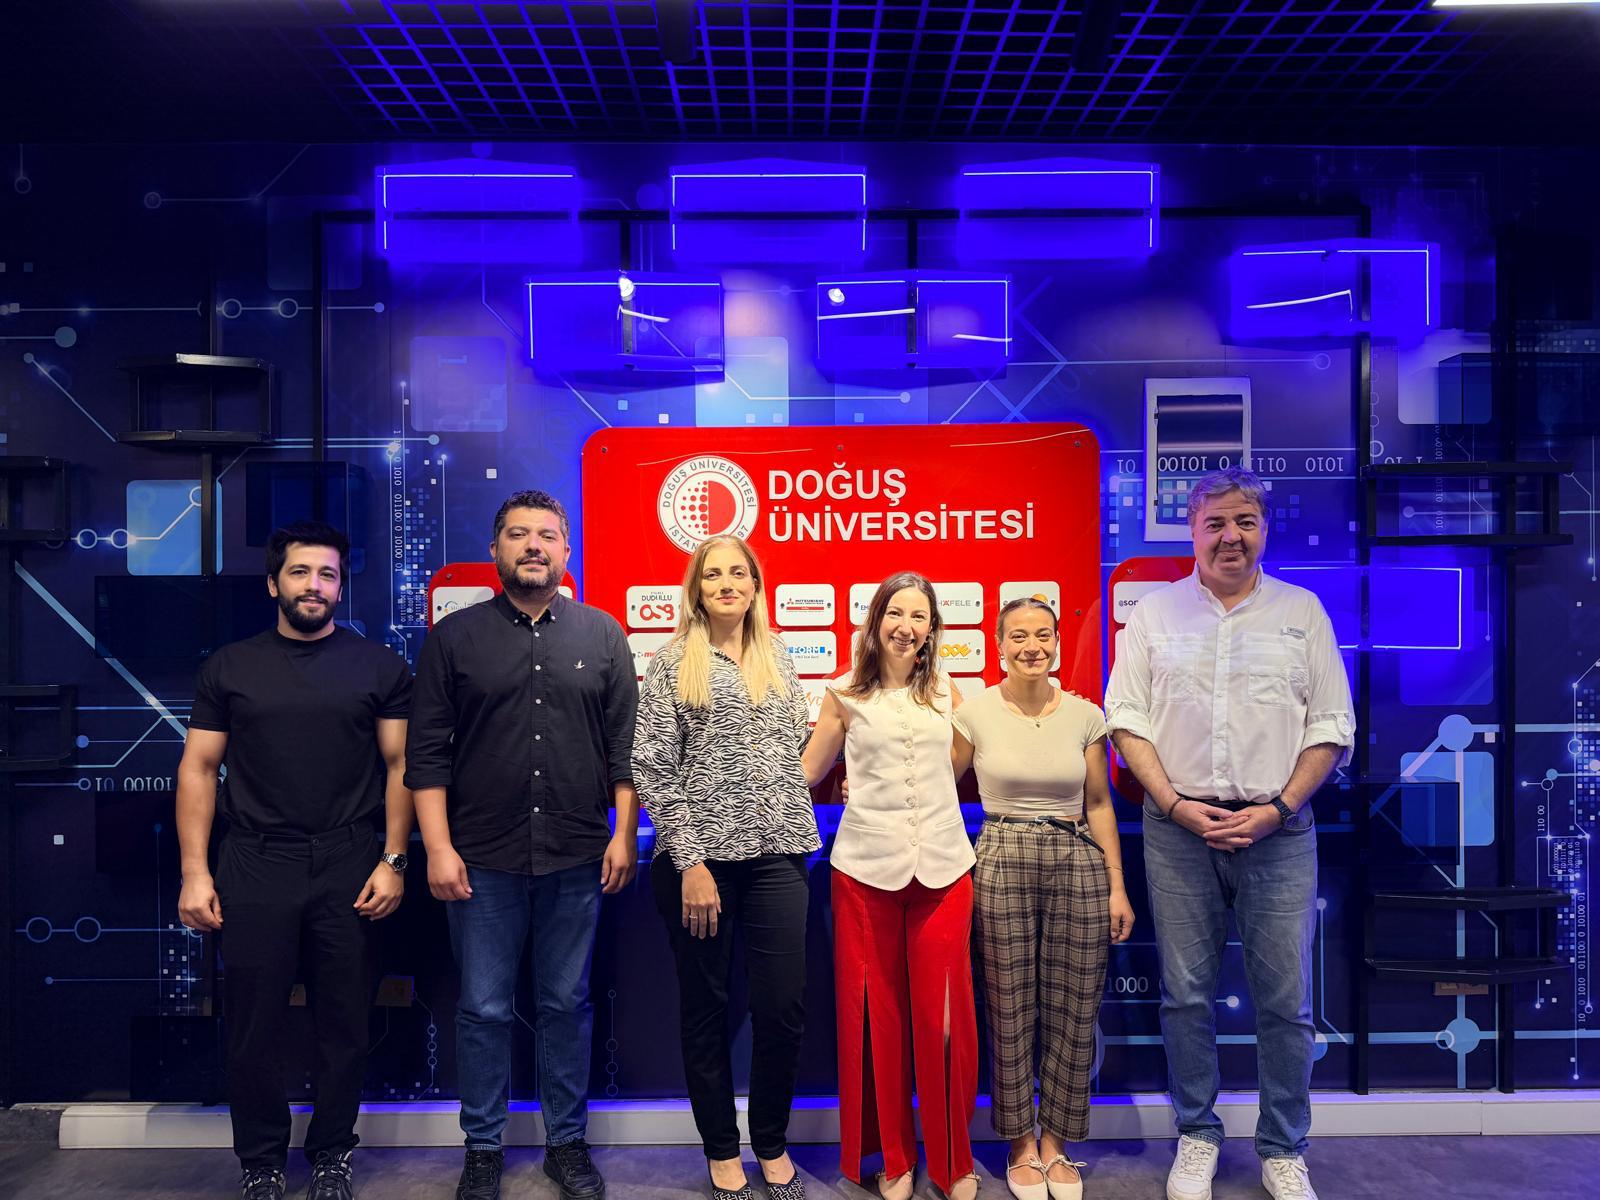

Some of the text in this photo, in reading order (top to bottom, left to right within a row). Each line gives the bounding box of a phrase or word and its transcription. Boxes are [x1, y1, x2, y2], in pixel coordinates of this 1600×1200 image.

[663, 459, 756, 508] DOĞUŞ ÜNİVERSİTESİ
[768, 462, 907, 507] DOĞUŞ
[768, 502, 1035, 542] ÜNİVERSİTESİ
